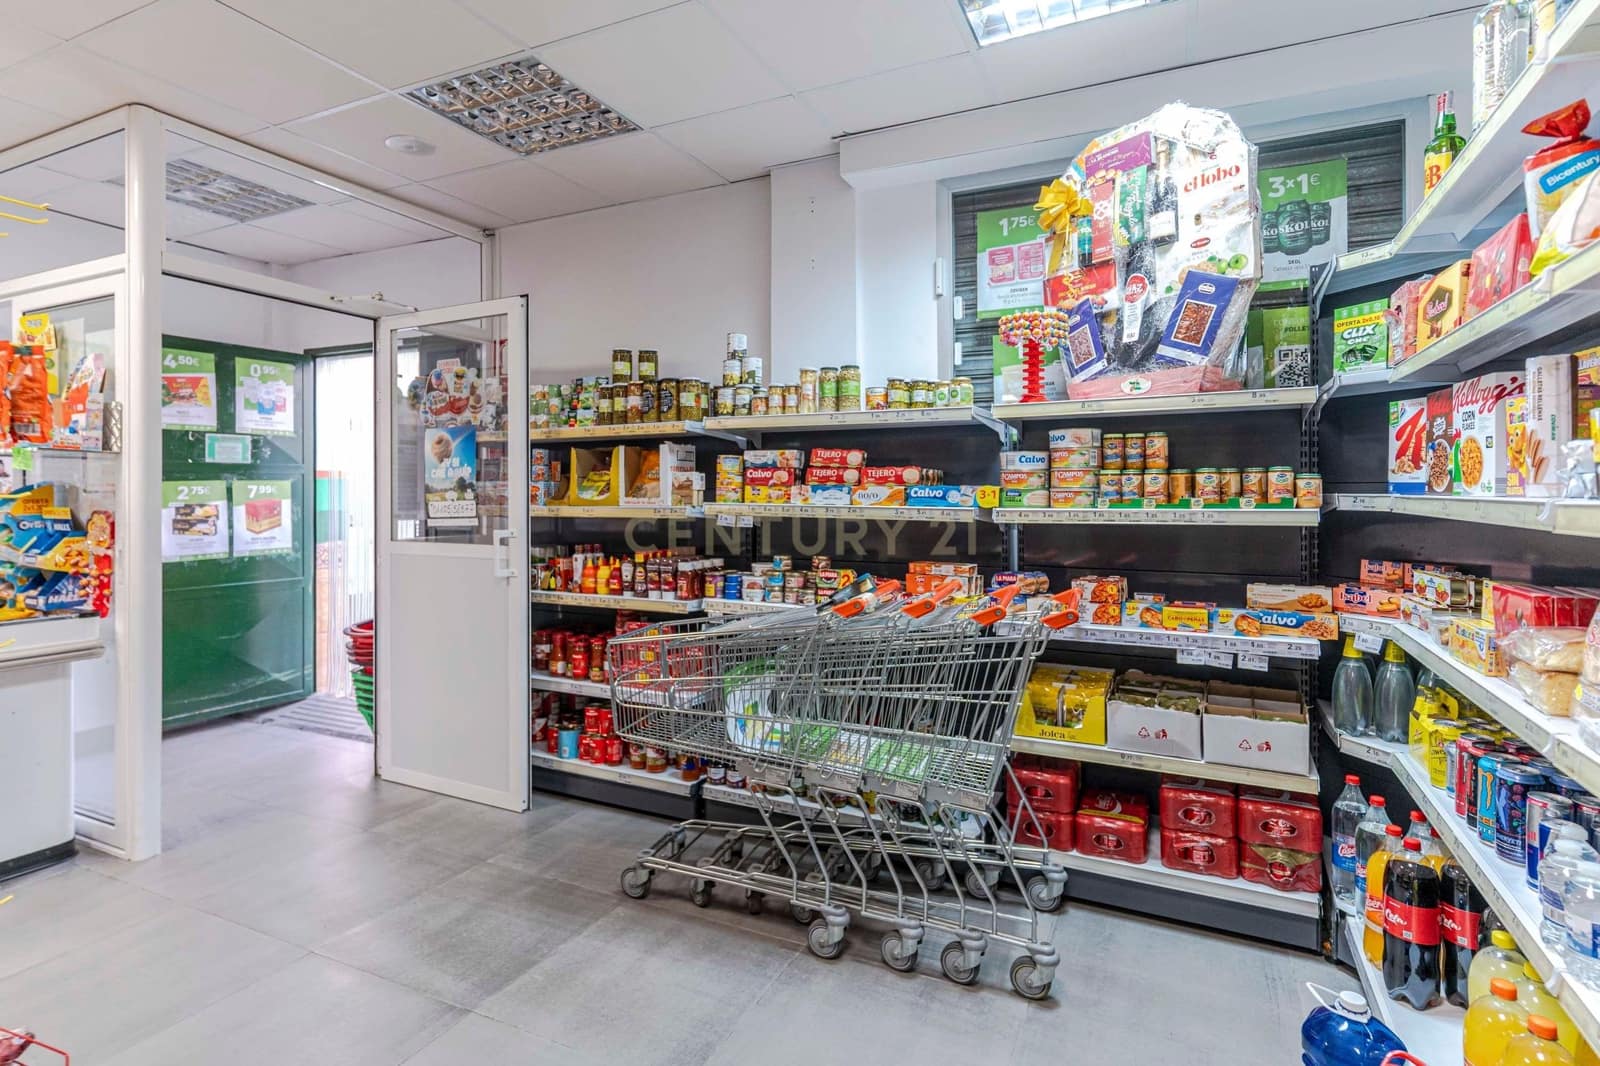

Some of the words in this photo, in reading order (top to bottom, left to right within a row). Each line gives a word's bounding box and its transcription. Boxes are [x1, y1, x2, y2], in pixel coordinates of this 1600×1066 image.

[1201, 164, 1241, 187] lobo
[1546, 155, 1600, 187] Bicentury
[1279, 220, 1311, 234] SKOL
[1311, 219, 1330, 228] KOL
[1342, 322, 1379, 340] CLIX
[1452, 376, 1526, 415] Kellogg's
[1018, 455, 1046, 464] Calvo
[746, 469, 772, 478] Calvo
[812, 469, 838, 478] TEJERO
[866, 469, 896, 478] TEJERO
[910, 487, 944, 498] Calvo
[1039, 729, 1065, 739] Jolca
